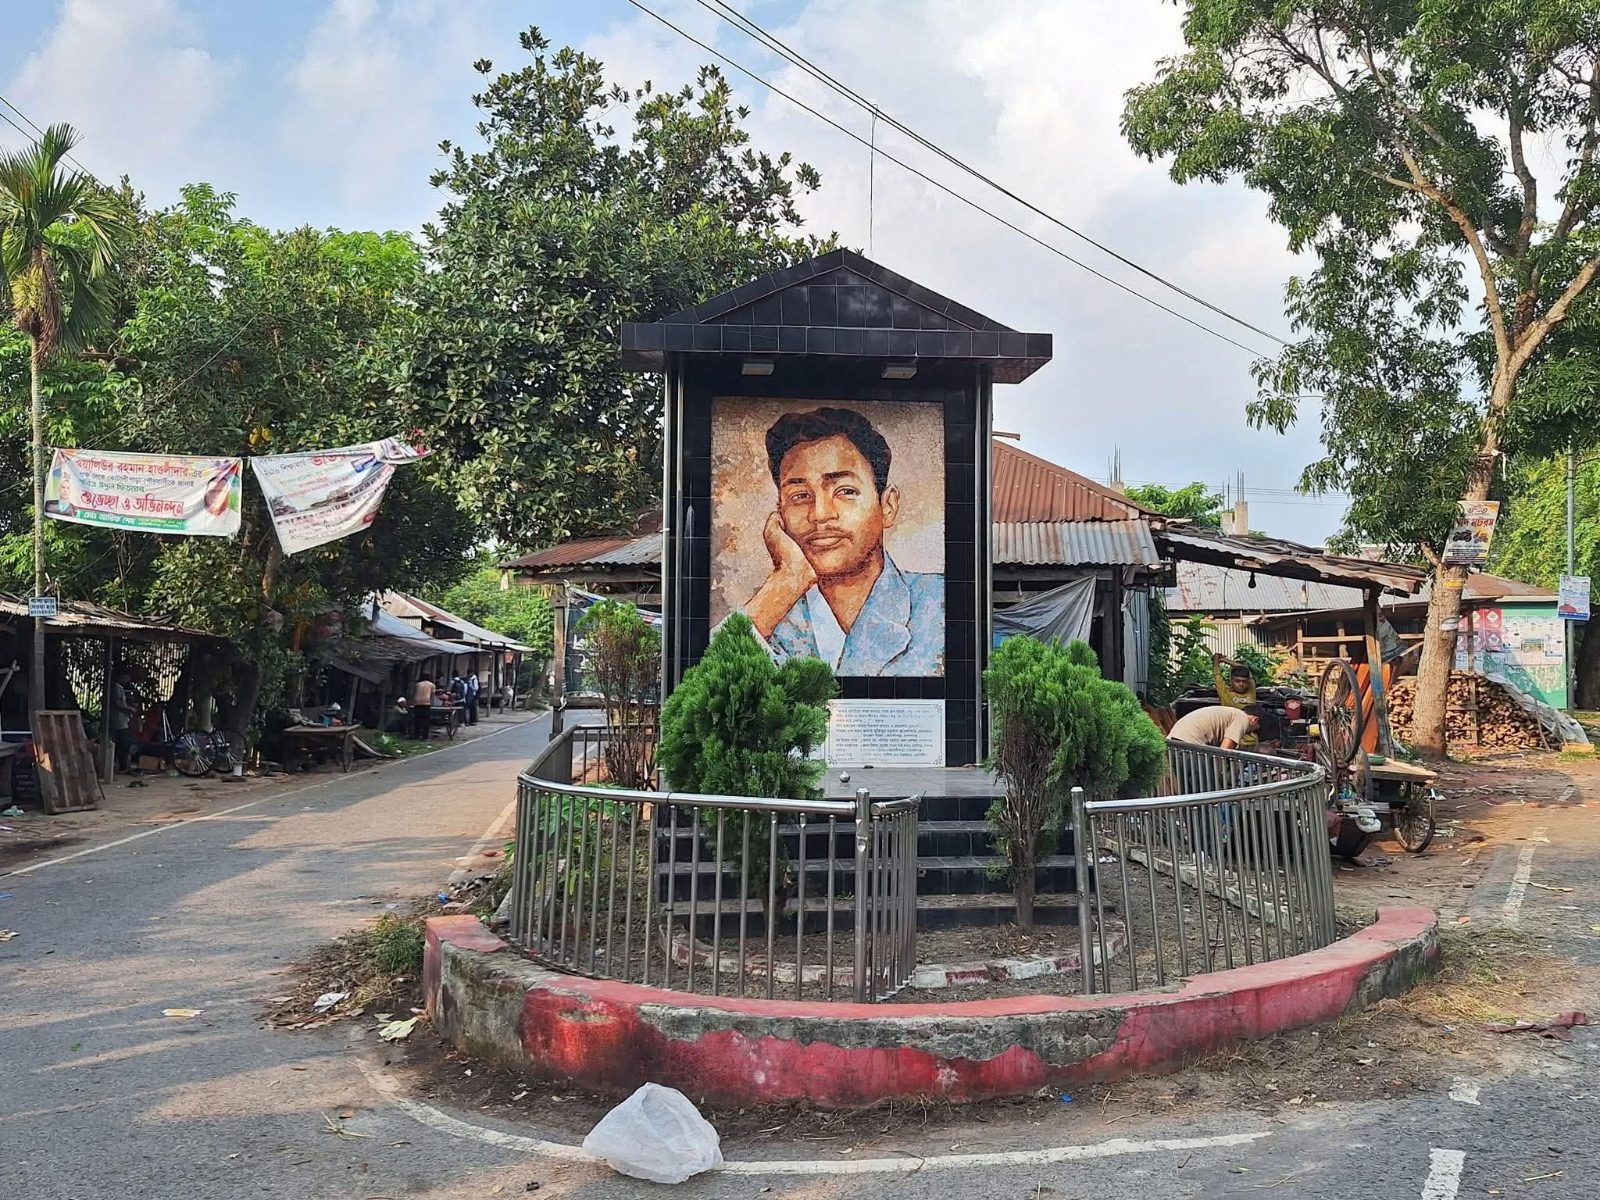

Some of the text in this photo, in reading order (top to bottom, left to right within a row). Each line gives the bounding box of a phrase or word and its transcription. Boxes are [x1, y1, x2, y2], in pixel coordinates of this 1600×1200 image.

[81, 490, 184, 516] শুভেচ্ছা ও অভিনন্দন
